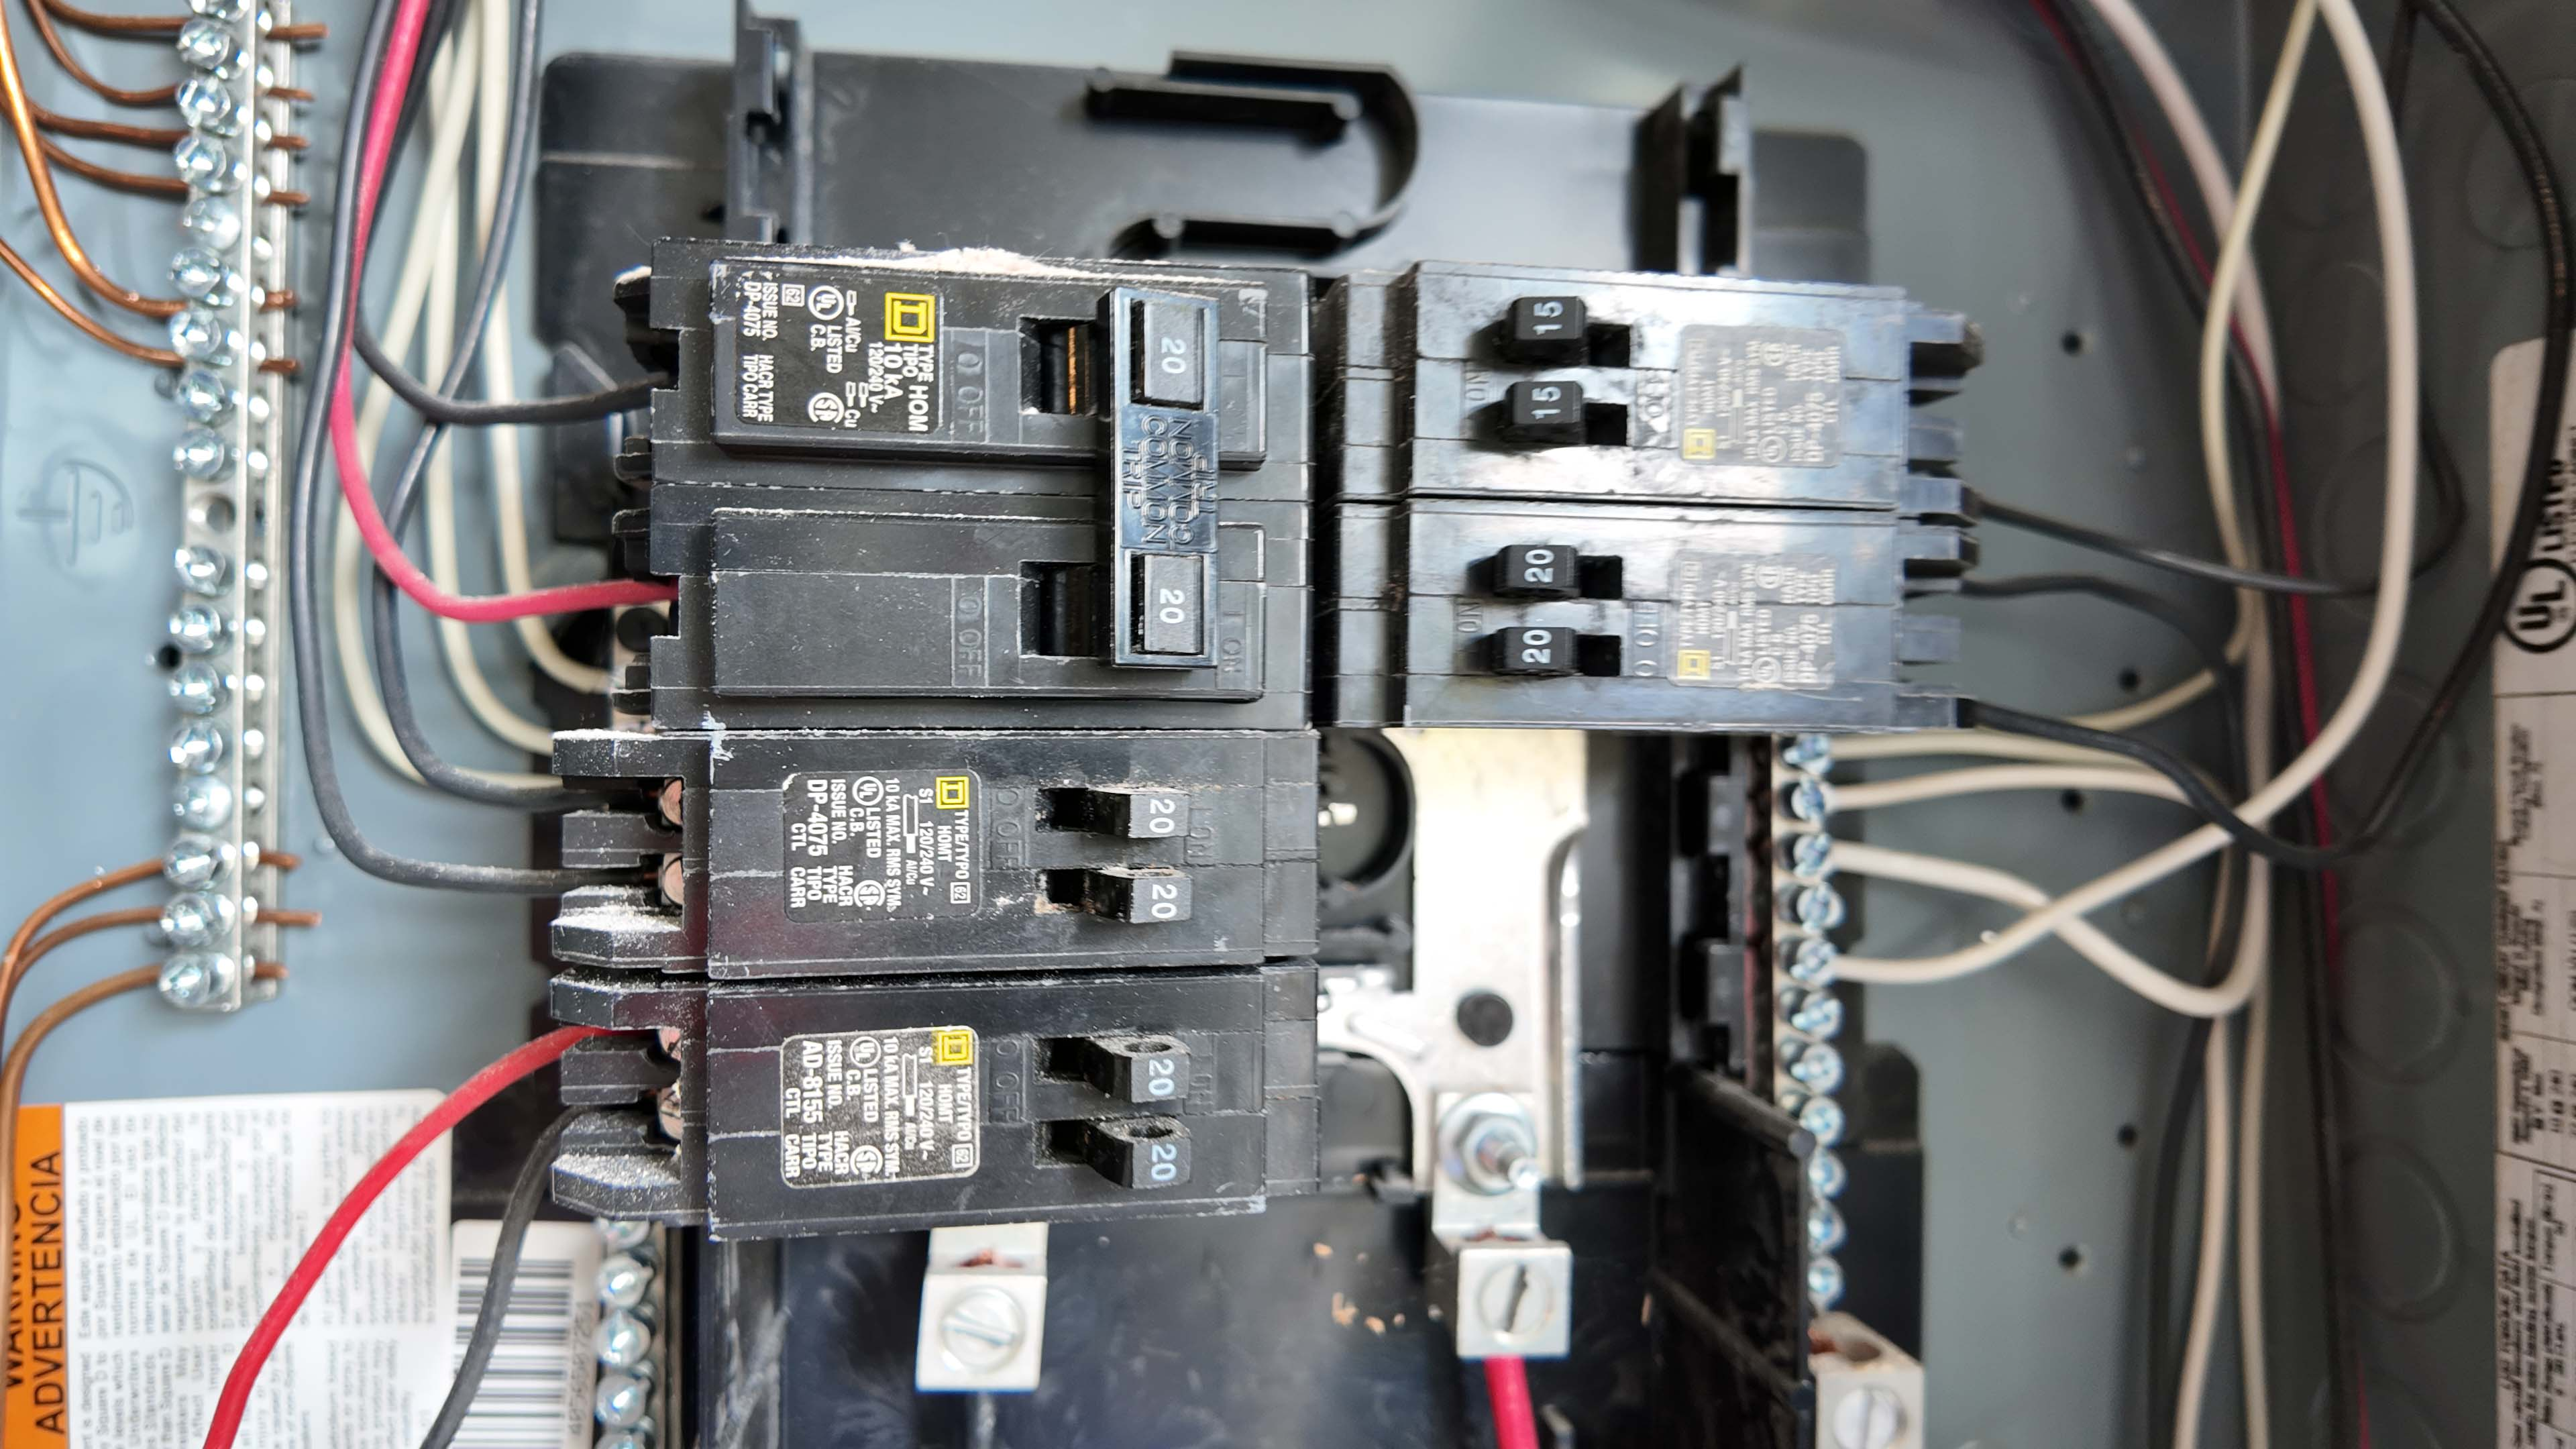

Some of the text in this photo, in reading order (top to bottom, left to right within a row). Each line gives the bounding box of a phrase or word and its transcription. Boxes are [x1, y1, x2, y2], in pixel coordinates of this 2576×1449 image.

[743, 282, 761, 336] DP-4075
[762, 282, 778, 341] ISSUE NO.
[786, 288, 800, 303] 62
[810, 324, 826, 351] C.B.
[1532, 301, 1563, 335] 15
[826, 325, 843, 374] LISTED
[869, 342, 883, 391] 120/240
[902, 344, 918, 377] TIPO
[918, 345, 934, 382] TYPE
[1159, 337, 1187, 374] 20
[743, 354, 757, 417] TIPO CARR
[758, 355, 774, 422] HACR TYPE
[883, 343, 903, 400] 10 kA
[845, 409, 860, 428] Cu
[908, 385, 928, 431] HOM
[957, 386, 983, 434] OFF
[1531, 386, 1562, 420] 15
[1122, 441, 1142, 510] TRIP
[1140, 416, 1168, 543] COMMON
[1523, 549, 1555, 583] 20
[1159, 588, 1185, 625] 20
[1457, 602, 1483, 633] ON
[2516, 581, 2565, 631] UL
[957, 628, 981, 678] OFF
[1521, 630, 1552, 663] 20
[885, 777, 900, 792] 10
[885, 796, 900, 812] kA
[919, 788, 933, 804] S1
[807, 779, 828, 856] DP-4075
[830, 779, 847, 844] ISSUE NO.
[849, 808, 864, 837] C.B.
[885, 815, 900, 846] MAX.
[1149, 798, 1175, 833] 20
[790, 823, 806, 851] CTL
[866, 807, 881, 858] LISTED
[920, 821, 934, 874] 120/240
[937, 825, 952, 862] HOMT
[997, 822, 1020, 869] OFF
[886, 849, 901, 876] RMS
[906, 859, 918, 885] Al/Cu
[953, 810, 969, 900] TYPE/TYPO 62
[790, 867, 806, 908] CARR
[807, 866, 822, 900] TIPO
[822, 865, 837, 904] TYPE
[838, 865, 853, 906] HACR
[1151, 884, 1178, 919] 20
[826, 1040, 843, 1109] ISSUE NO.
[918, 1046, 934, 1064] S1
[802, 1040, 823, 1124] AD-8155
[846, 1069, 861, 1100] C.B.
[863, 1069, 879, 1122] LISTED
[1148, 1059, 1175, 1096] 20
[786, 1087, 800, 1118] CTL
[883, 1037, 900, 1177] 10 kA MAX. RMS SYM.
[919, 1081, 934, 1138] 120/240
[938, 1084, 953, 1124] HOMT
[956, 1067, 972, 1140] TYPE/TYPO
[996, 1073, 1020, 1122] OFF
[785, 1134, 800, 1178] CARR
[801, 1132, 817, 1169] TIPO
[818, 1132, 833, 1171] TYPE
[834, 1131, 849, 1175] HACR
[1150, 1143, 1177, 1181] 20
[30, 1151, 65, 1434] ADVERTENCIA
